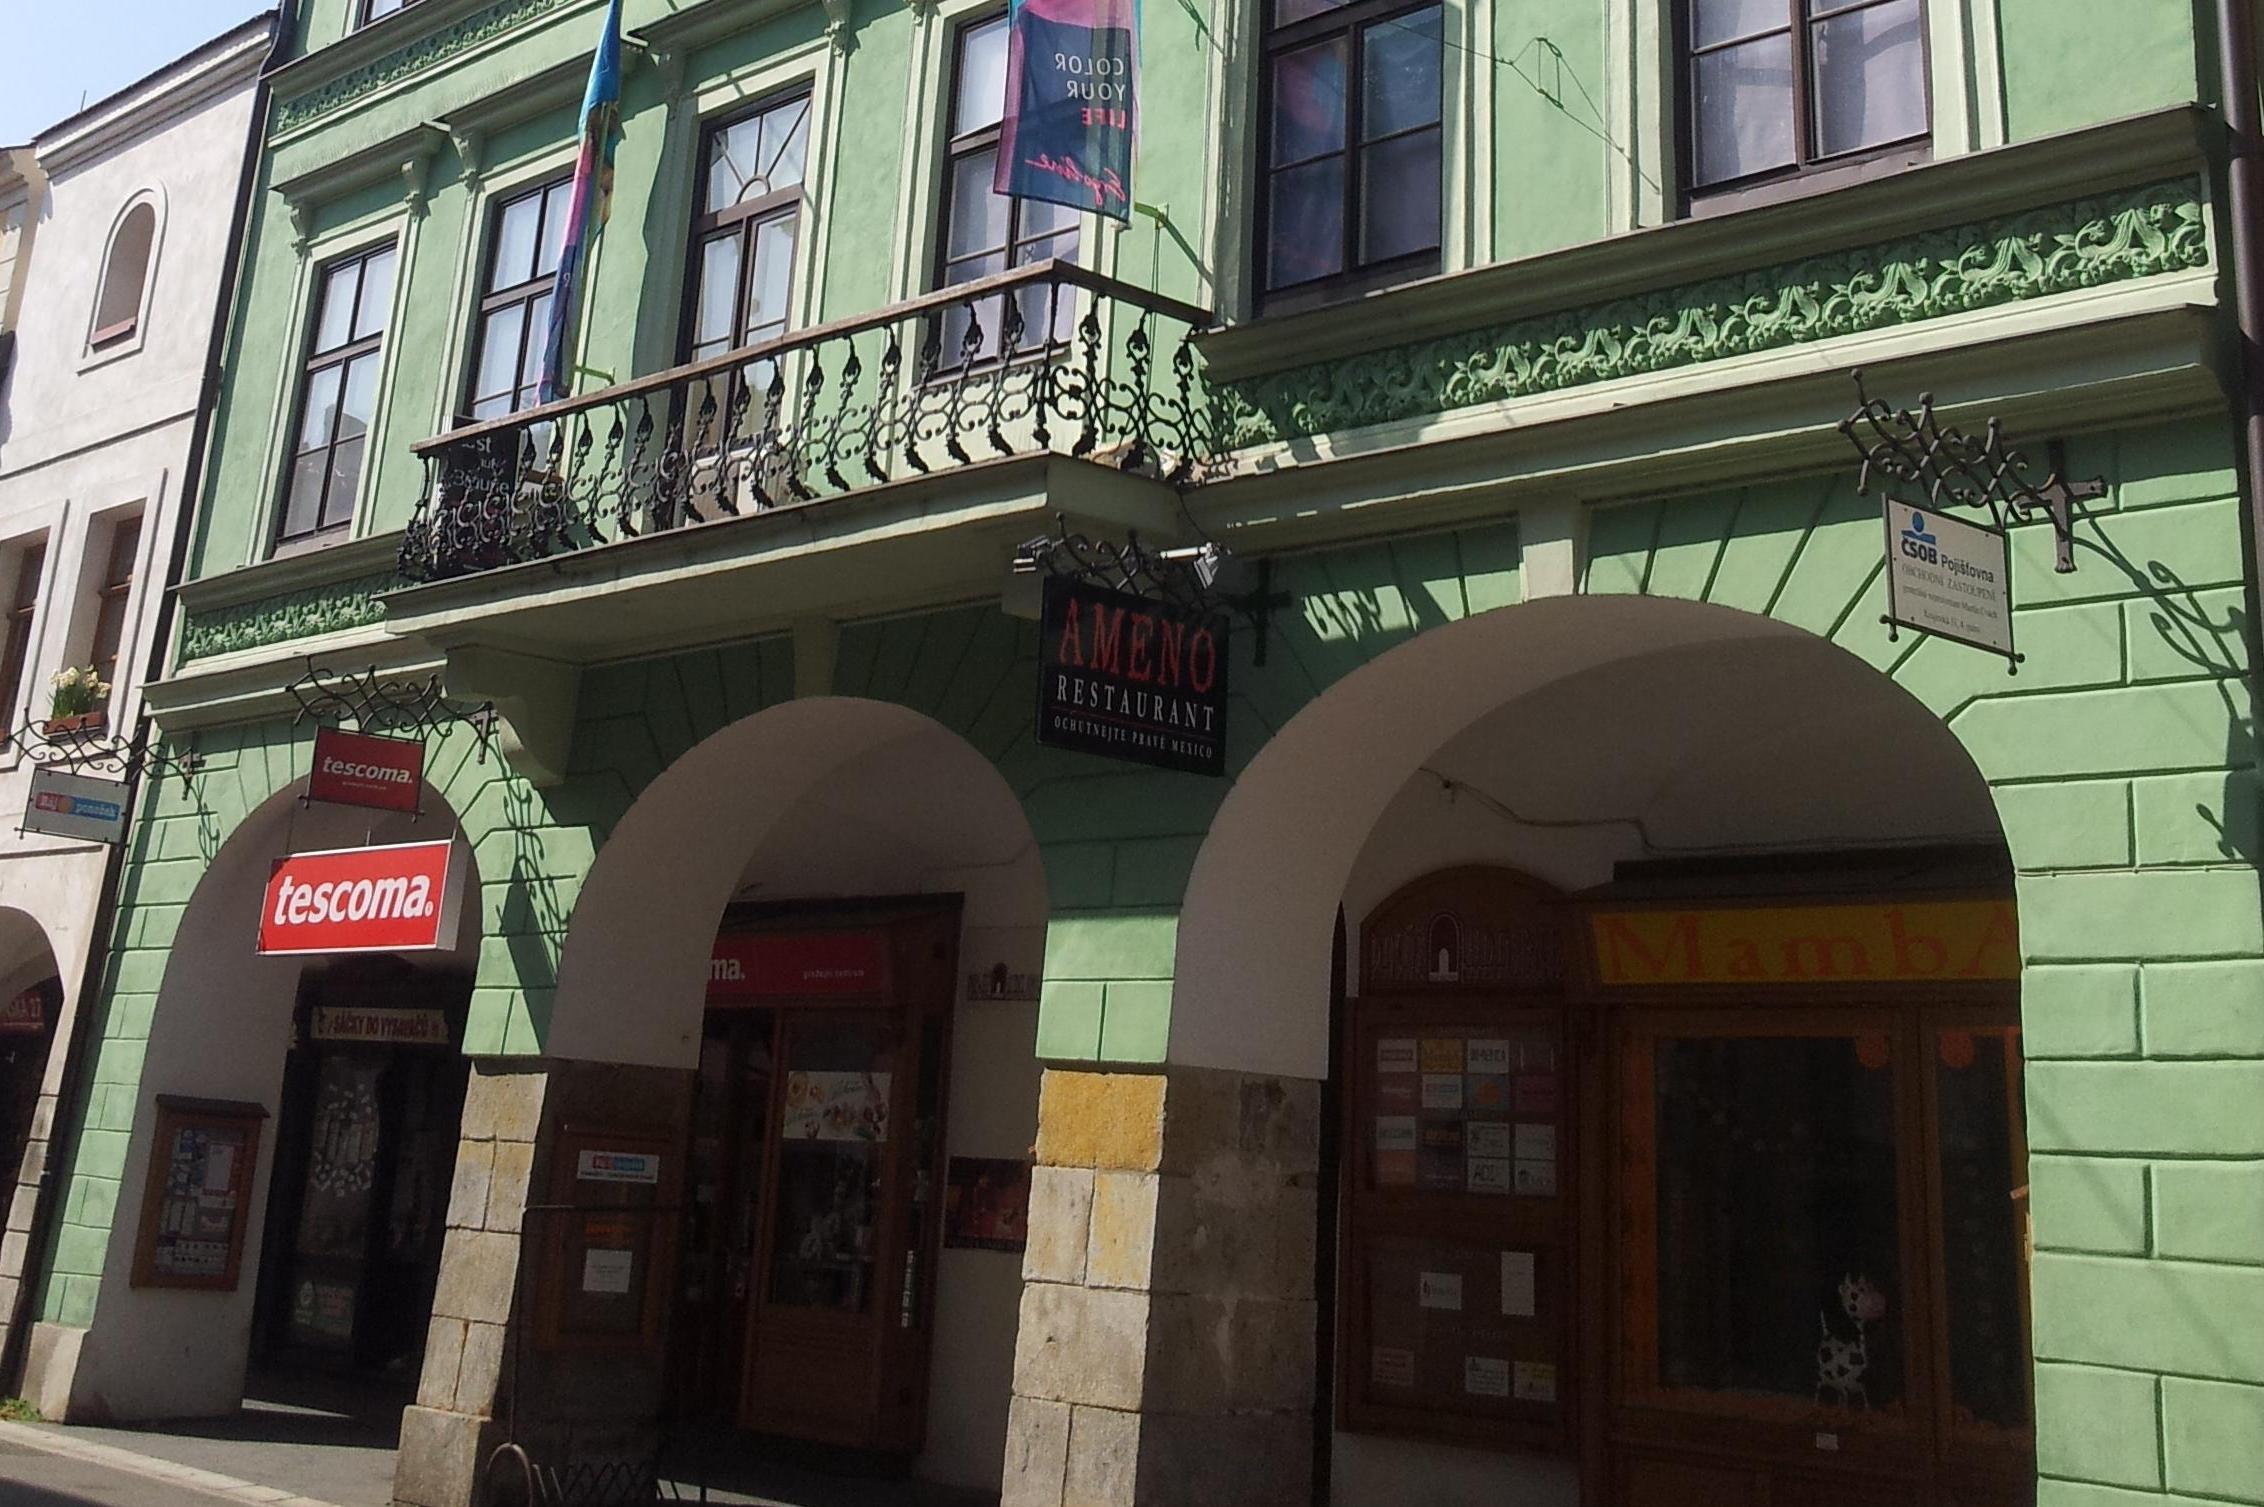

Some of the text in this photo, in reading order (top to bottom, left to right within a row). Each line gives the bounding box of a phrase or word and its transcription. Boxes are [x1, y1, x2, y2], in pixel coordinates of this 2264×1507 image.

[1901, 538, 1994, 583] ČSOB Pojišťovna
[1058, 598, 1216, 693] AMENO
[1057, 674, 1214, 732] RESTAURANT
[1054, 715, 1126, 742] OCHUTNEJTE
[1172, 739, 1213, 760] MEXICO
[323, 756, 413, 784] tescoma.
